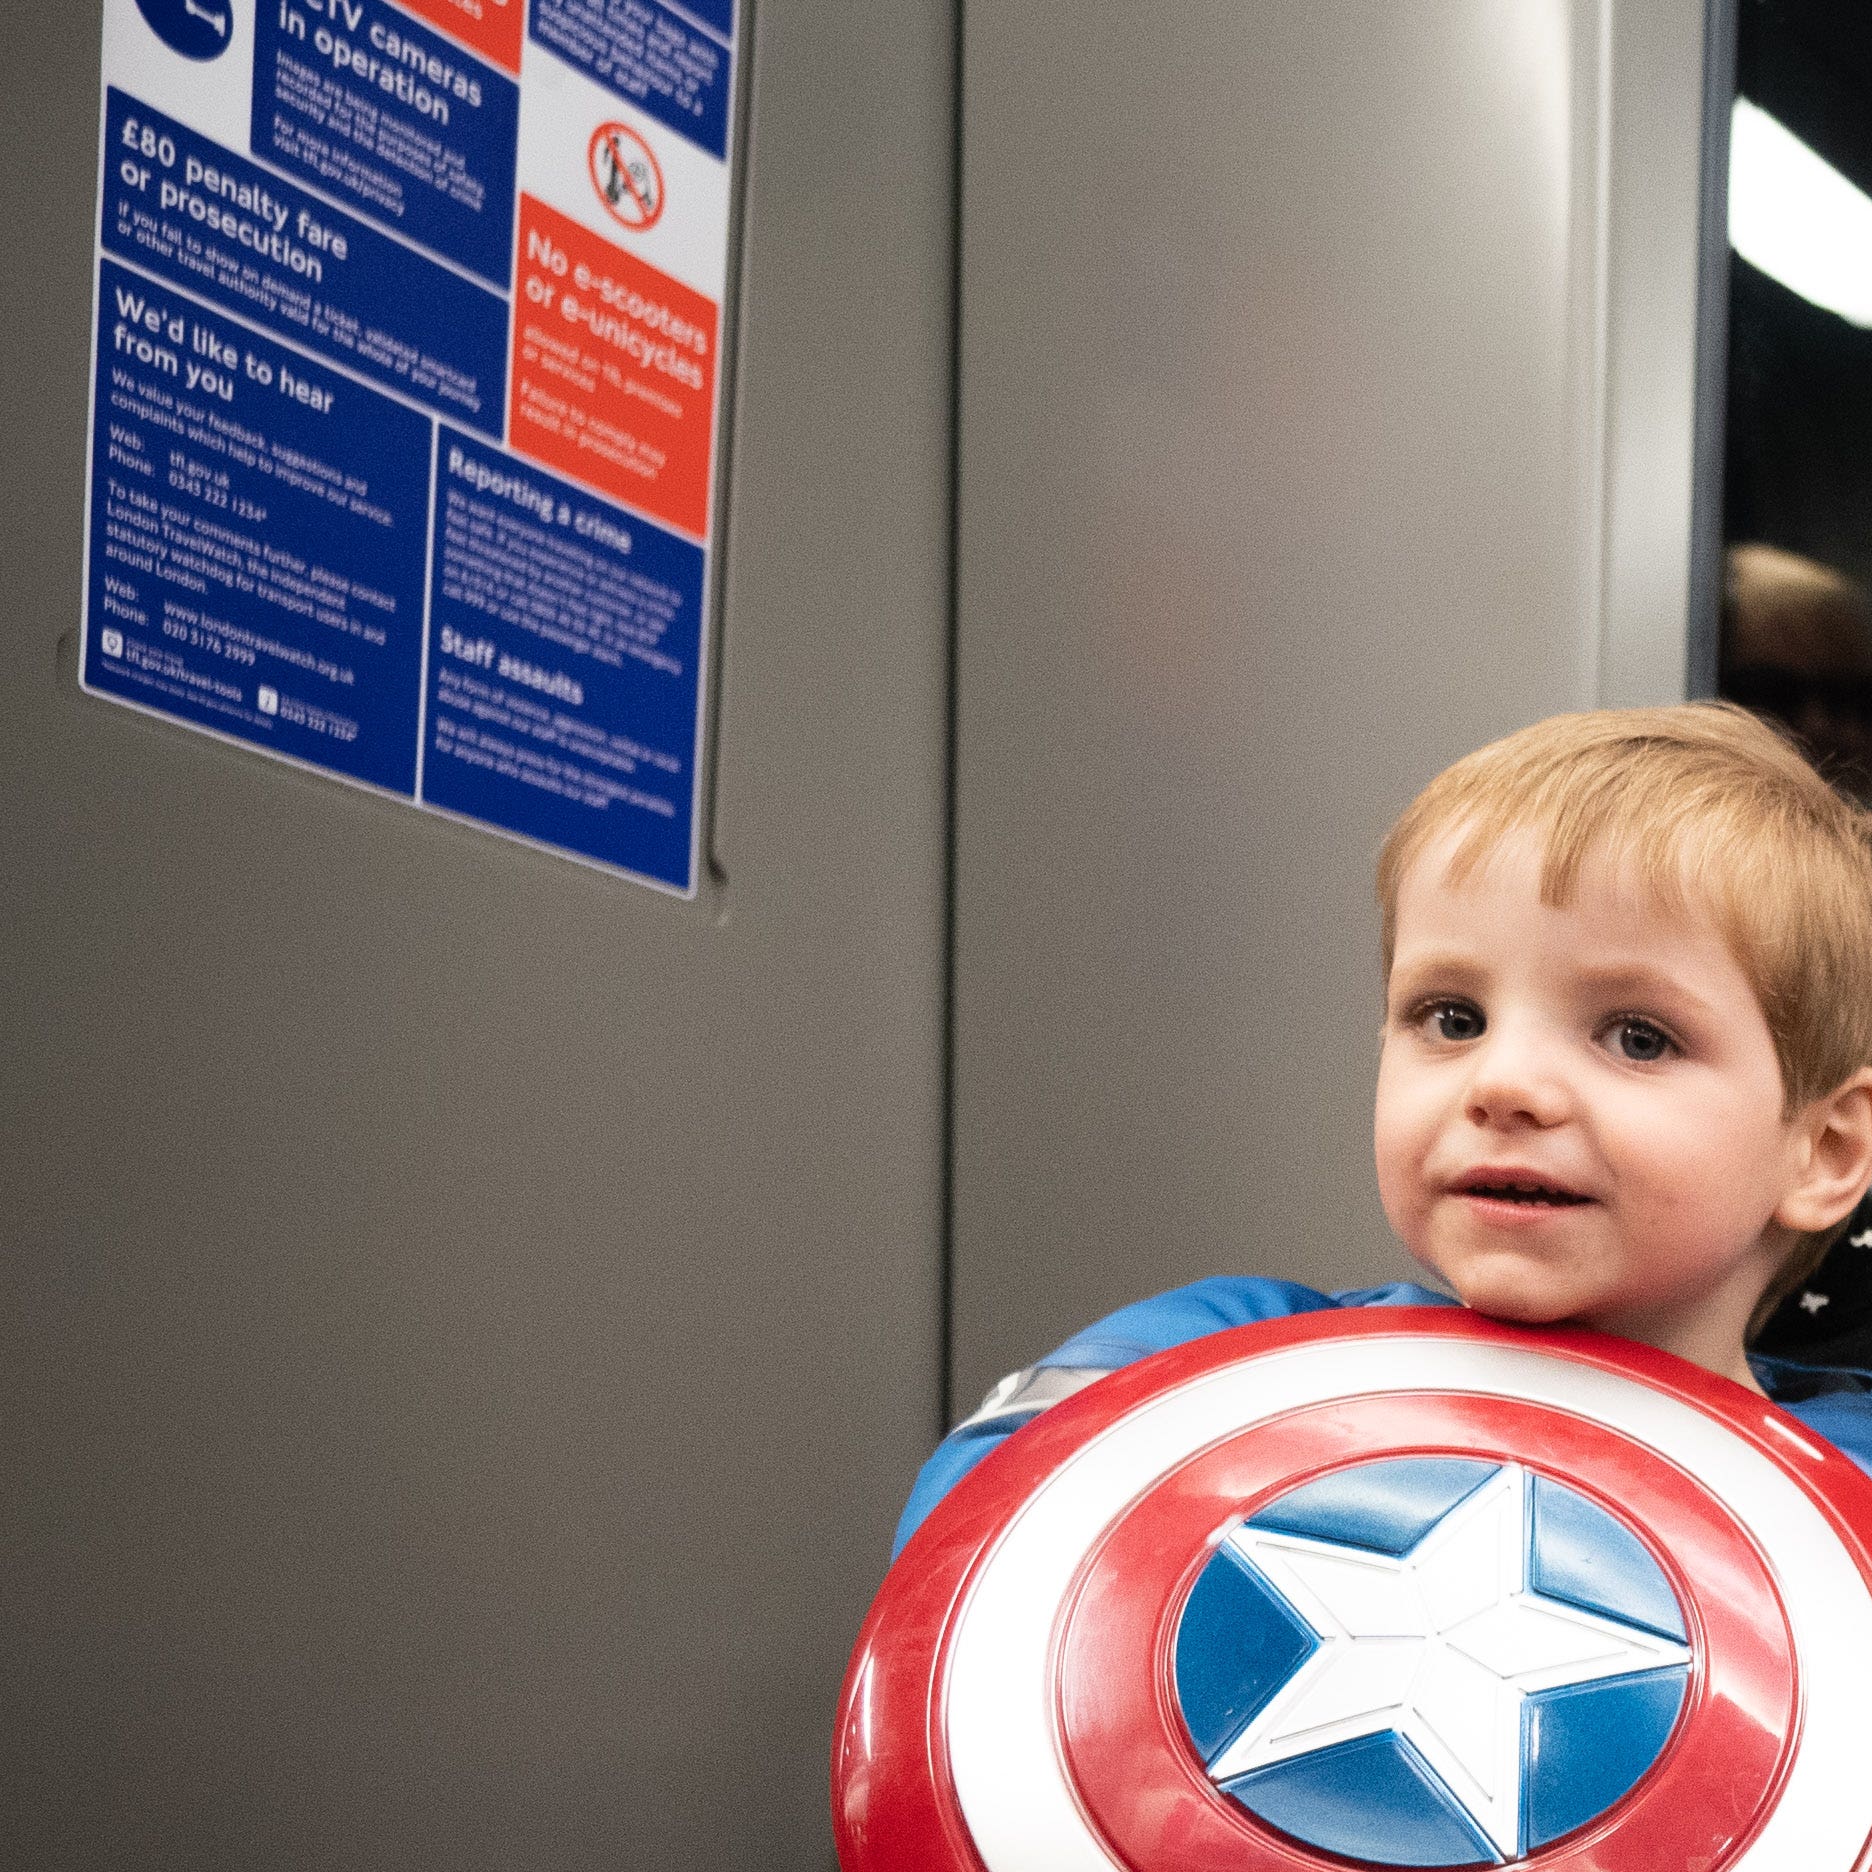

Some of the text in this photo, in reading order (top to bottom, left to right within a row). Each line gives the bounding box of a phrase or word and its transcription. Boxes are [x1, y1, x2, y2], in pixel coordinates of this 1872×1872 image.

[314, 26, 449, 126] operation
[369, 22, 482, 107] cameras
[121, 161, 322, 282] or prosecution
[123, 119, 347, 259] £80 penalty fare
[118, 220, 132, 236] or
[136, 230, 173, 257] other
[177, 247, 214, 278] travel
[218, 271, 277, 311] authority
[280, 303, 309, 326] valid
[312, 314, 330, 335] for
[333, 324, 354, 348] the
[357, 340, 393, 367] whole
[395, 356, 410, 374] of
[411, 368, 437, 388] your
[119, 202, 129, 217] If
[133, 211, 158, 238] you
[162, 223, 182, 250] fail
[186, 236, 202, 254] to
[205, 247, 239, 278] show
[241, 266, 259, 284] on
[262, 276, 311, 314] demand
[313, 302, 321, 318] a
[528, 230, 707, 354] No e-scooters
[114, 323, 233, 401] from you
[116, 288, 333, 413] We'd like to hear
[526, 276, 703, 390] or e-unicycles
[109, 443, 153, 475] Phone:
[169, 471, 201, 496] 0343
[205, 486, 227, 508] 222
[110, 424, 142, 450] Web:
[111, 392, 184, 434] complaints
[187, 426, 226, 452] which
[228, 442, 256, 466] help
[258, 455, 273, 473] to
[275, 464, 325, 497] improve
[327, 488, 348, 506] our
[112, 368, 135, 391] We
[138, 384, 173, 409] value
[176, 401, 205, 423] your
[344, 477, 367, 496] and
[107, 499, 159, 533] London
[247, 559, 268, 579] the
[271, 569, 345, 610] independent
[108, 478, 126, 500] To
[129, 490, 158, 513] take
[161, 505, 191, 526] your
[194, 519, 261, 556] comments
[311, 568, 349, 593] please
[351, 585, 395, 612] contact
[449, 445, 632, 555] Reporting a crime
[105, 576, 138, 600] Web:
[106, 544, 153, 572] around
[107, 523, 386, 645] statutory watchdog for transport users in and
[104, 595, 148, 625] Phone:
[163, 619, 187, 640] 020
[191, 629, 221, 654] 3176
[225, 642, 255, 665] 2999
[440, 624, 496, 670] Staff
[498, 650, 584, 706] assaults
